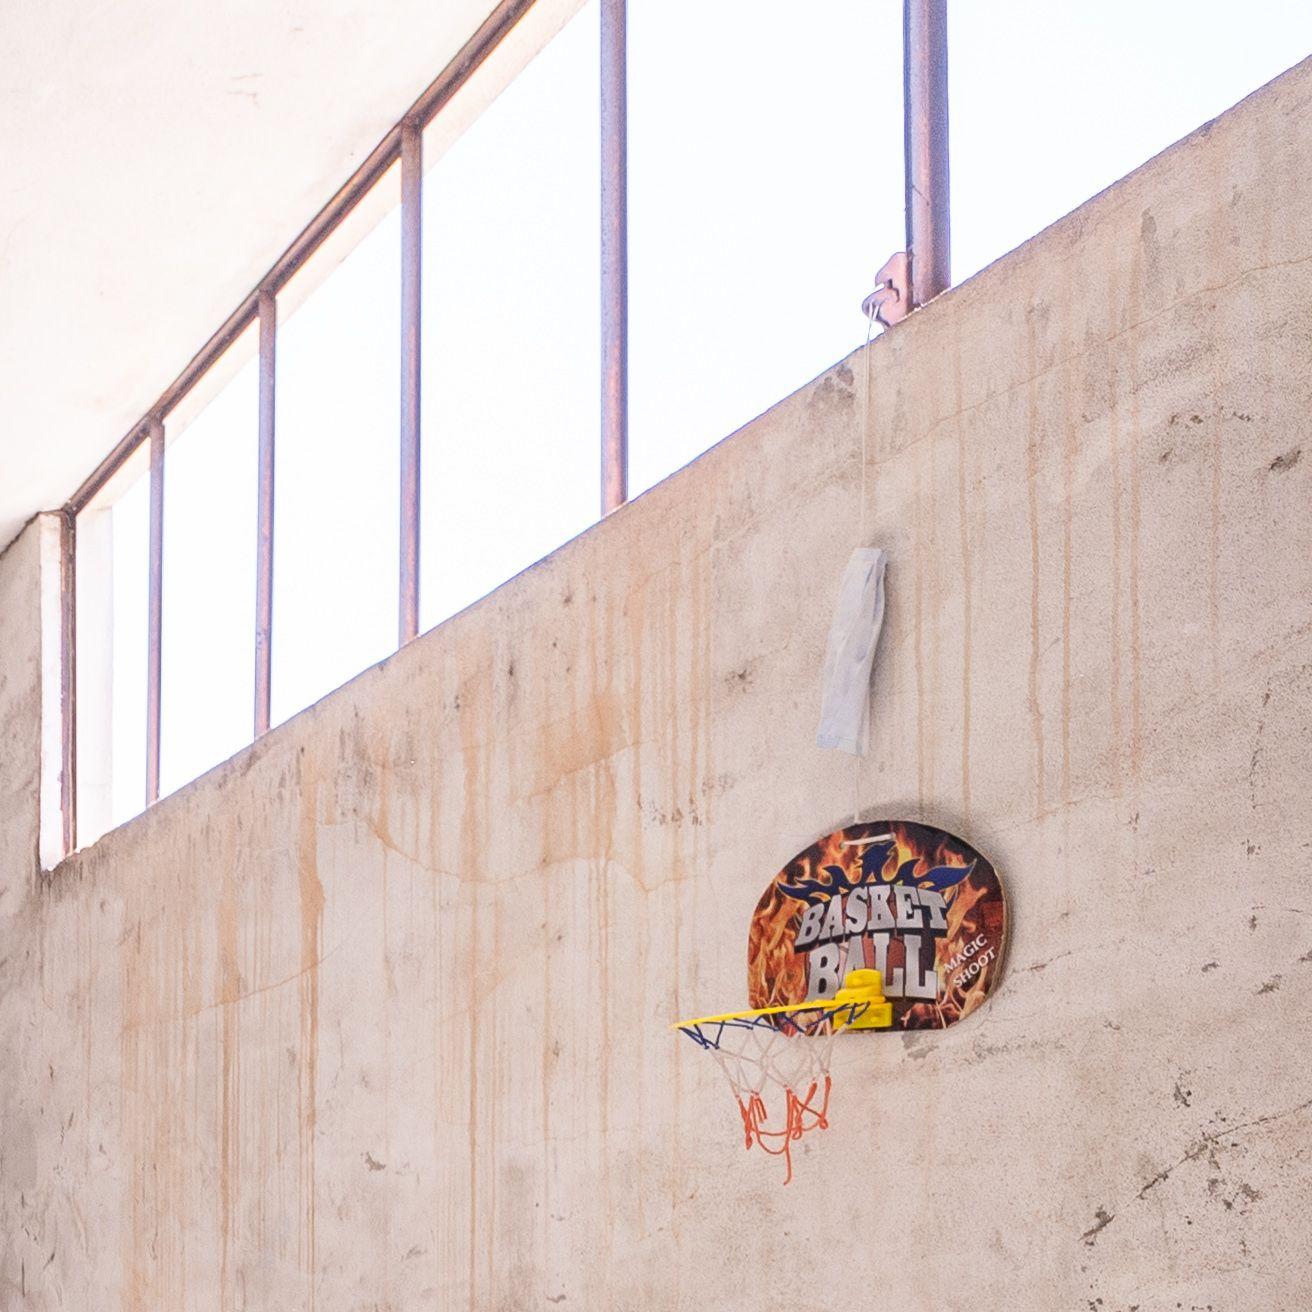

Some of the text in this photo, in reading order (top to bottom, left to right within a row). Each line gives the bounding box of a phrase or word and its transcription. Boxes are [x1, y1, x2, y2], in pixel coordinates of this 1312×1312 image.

[794, 884, 949, 949] BASKET
[943, 933, 988, 973] MAGIC
[953, 946, 995, 988] SHOOT
